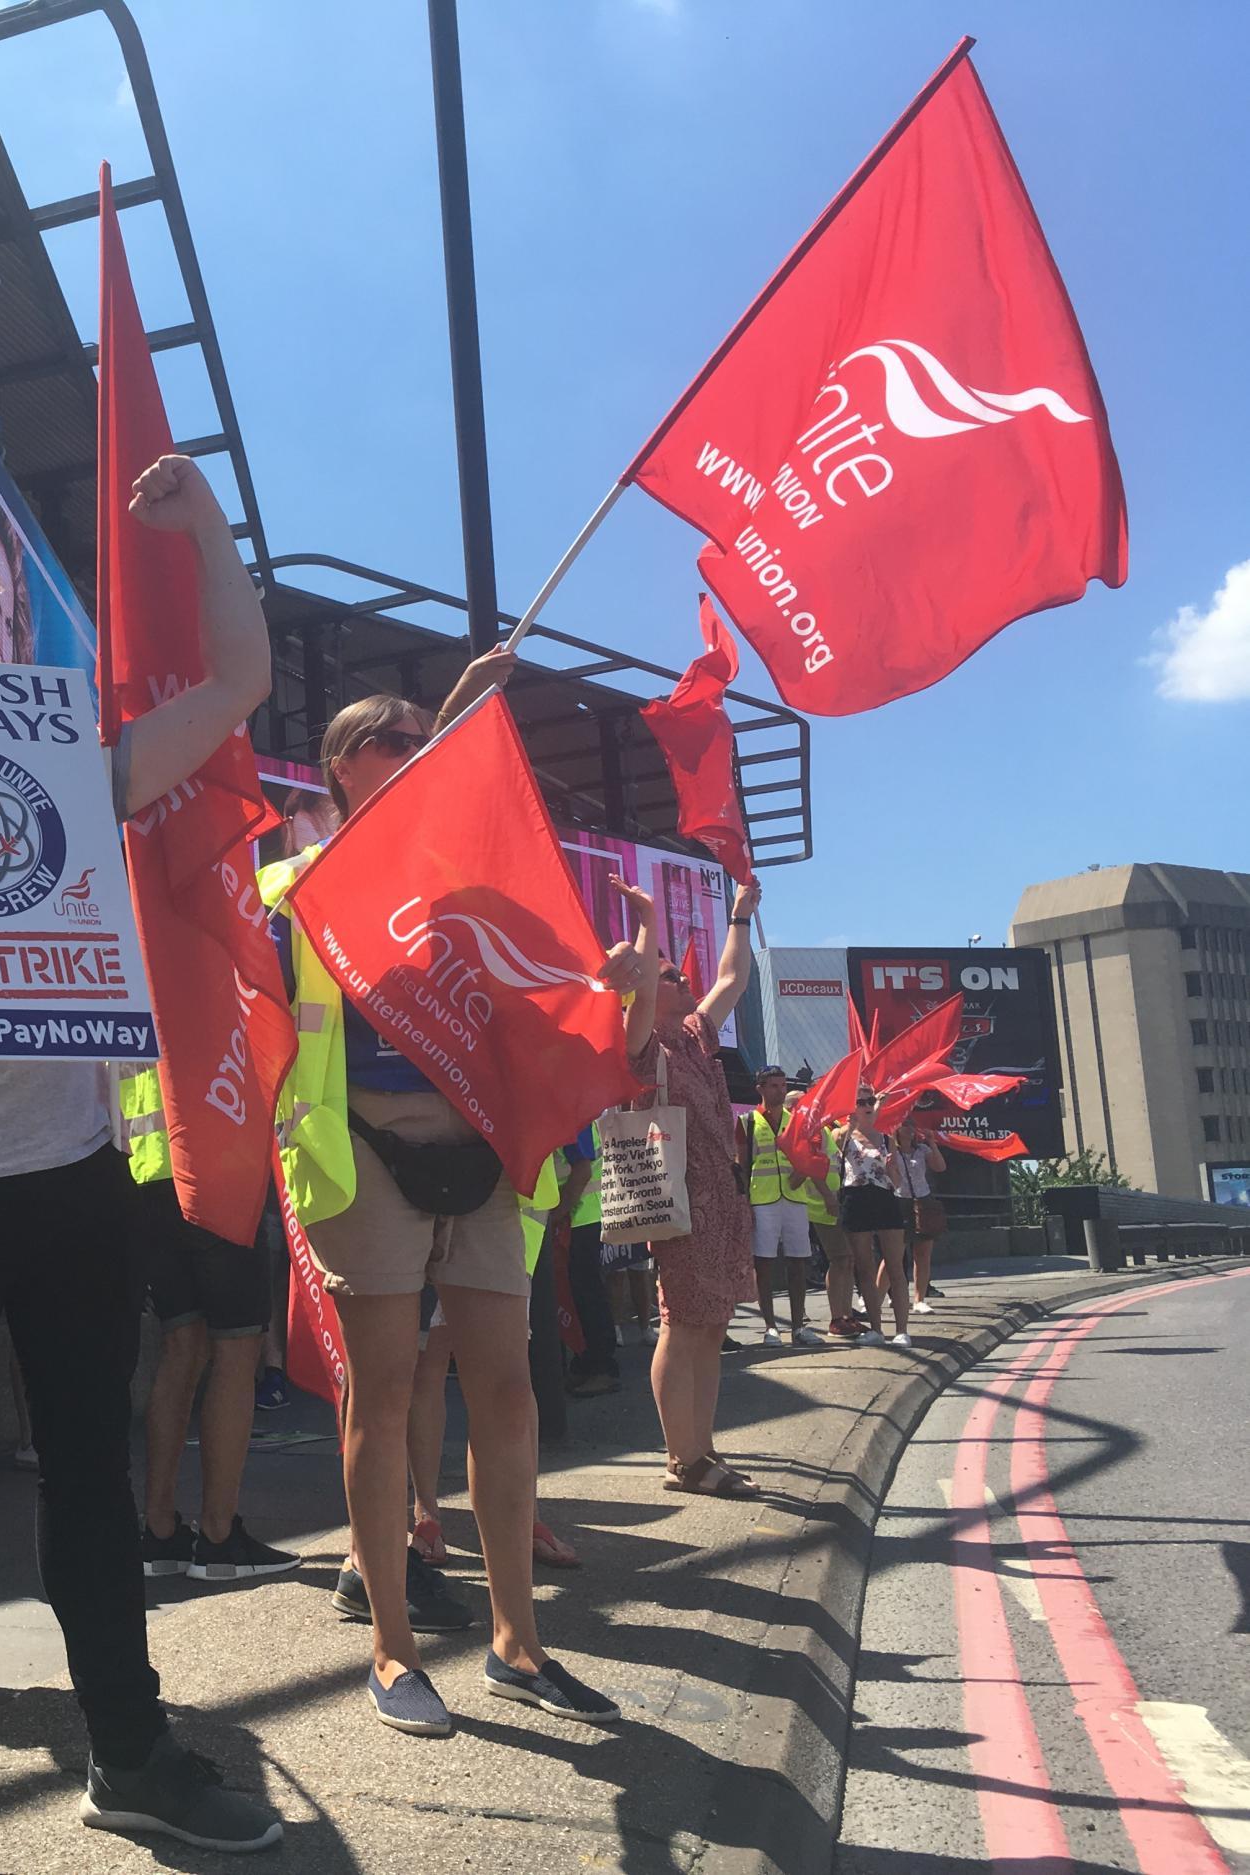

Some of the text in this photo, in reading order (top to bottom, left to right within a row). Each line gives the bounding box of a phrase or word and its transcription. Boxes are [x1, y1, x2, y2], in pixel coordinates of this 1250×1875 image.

[0, 761, 53, 814] UNITE
[872, 966, 1020, 991] IT'S ON
[781, 983, 841, 995] JCDecaux
[321, 923, 495, 1135] www.unitetheunion.org
[940, 1116, 990, 1128] JULY 14
[985, 1129, 996, 1139] in
